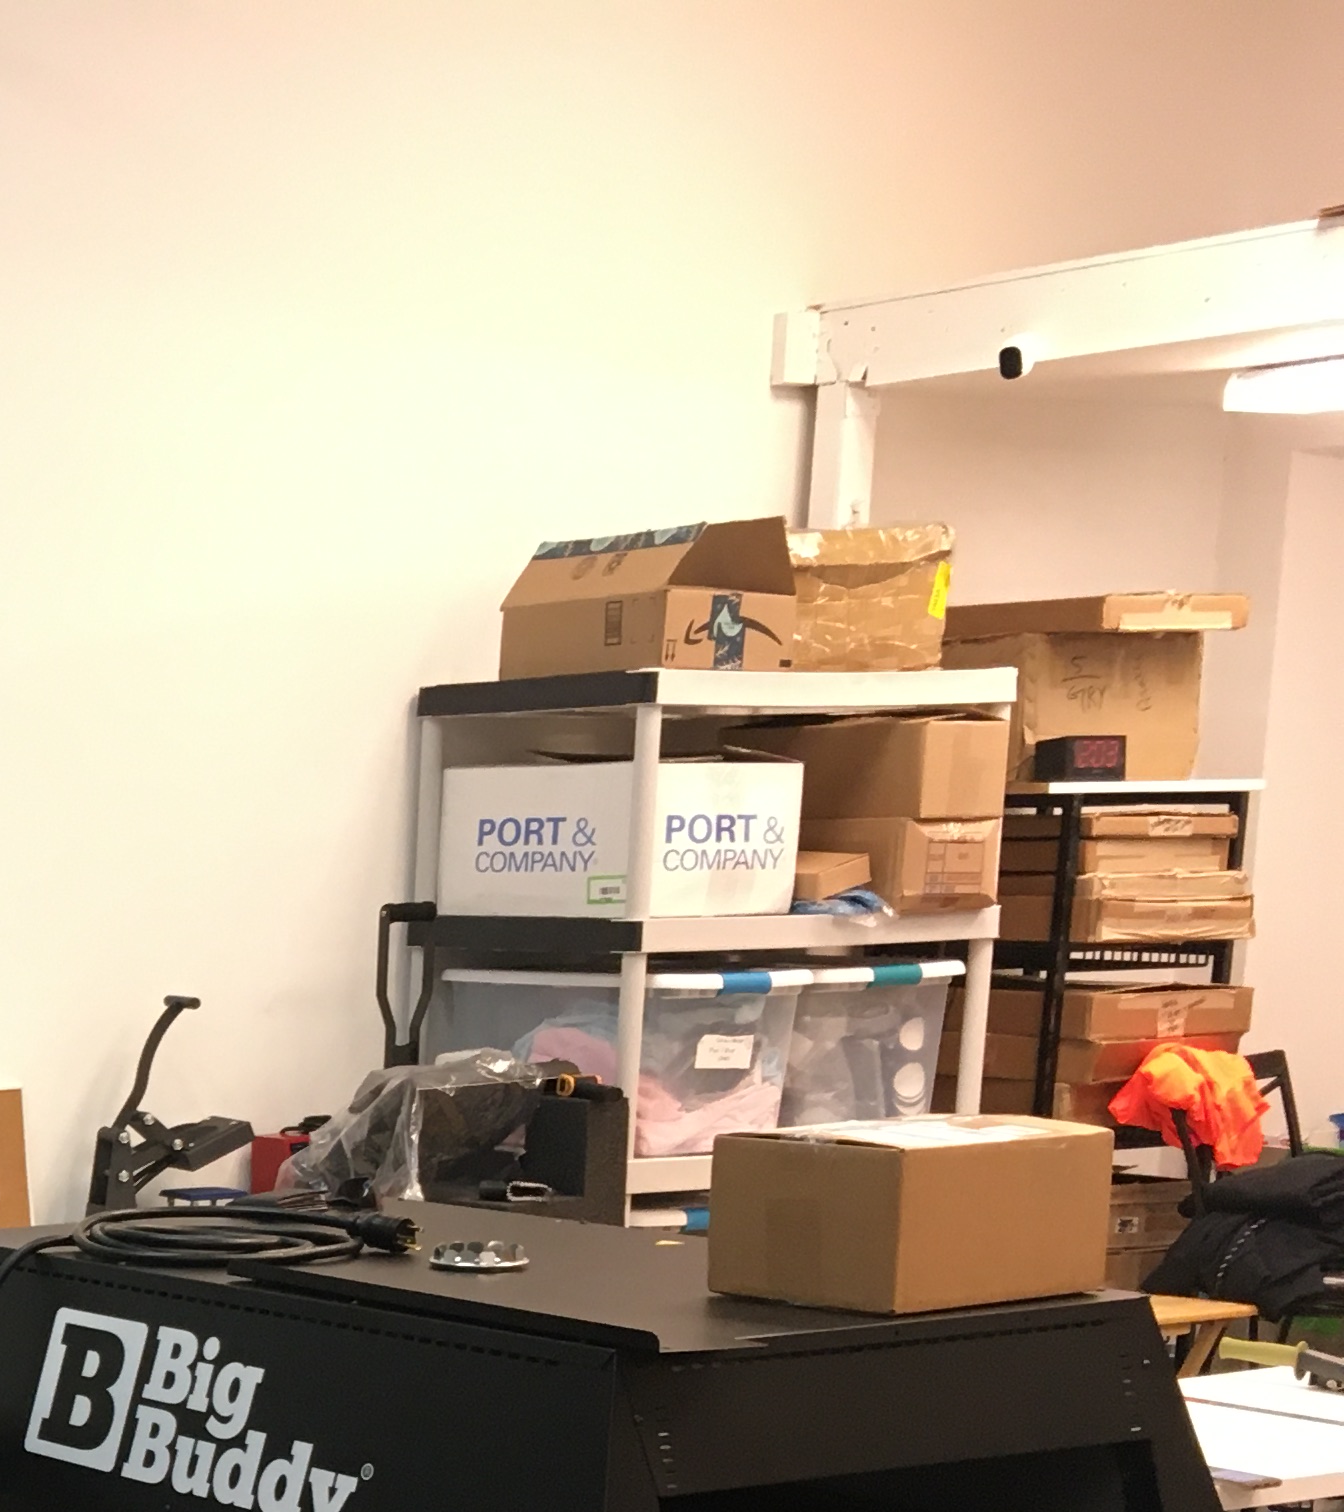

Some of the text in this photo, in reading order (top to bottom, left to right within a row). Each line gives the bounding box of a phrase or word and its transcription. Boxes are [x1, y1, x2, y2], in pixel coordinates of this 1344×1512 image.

[477, 816, 597, 847] PORT &
[665, 813, 785, 844] PORT &
[474, 850, 596, 873] COMPANY
[662, 848, 785, 872] COMPANY
[37, 1322, 126, 1451] B
[141, 1325, 266, 1440] Big
